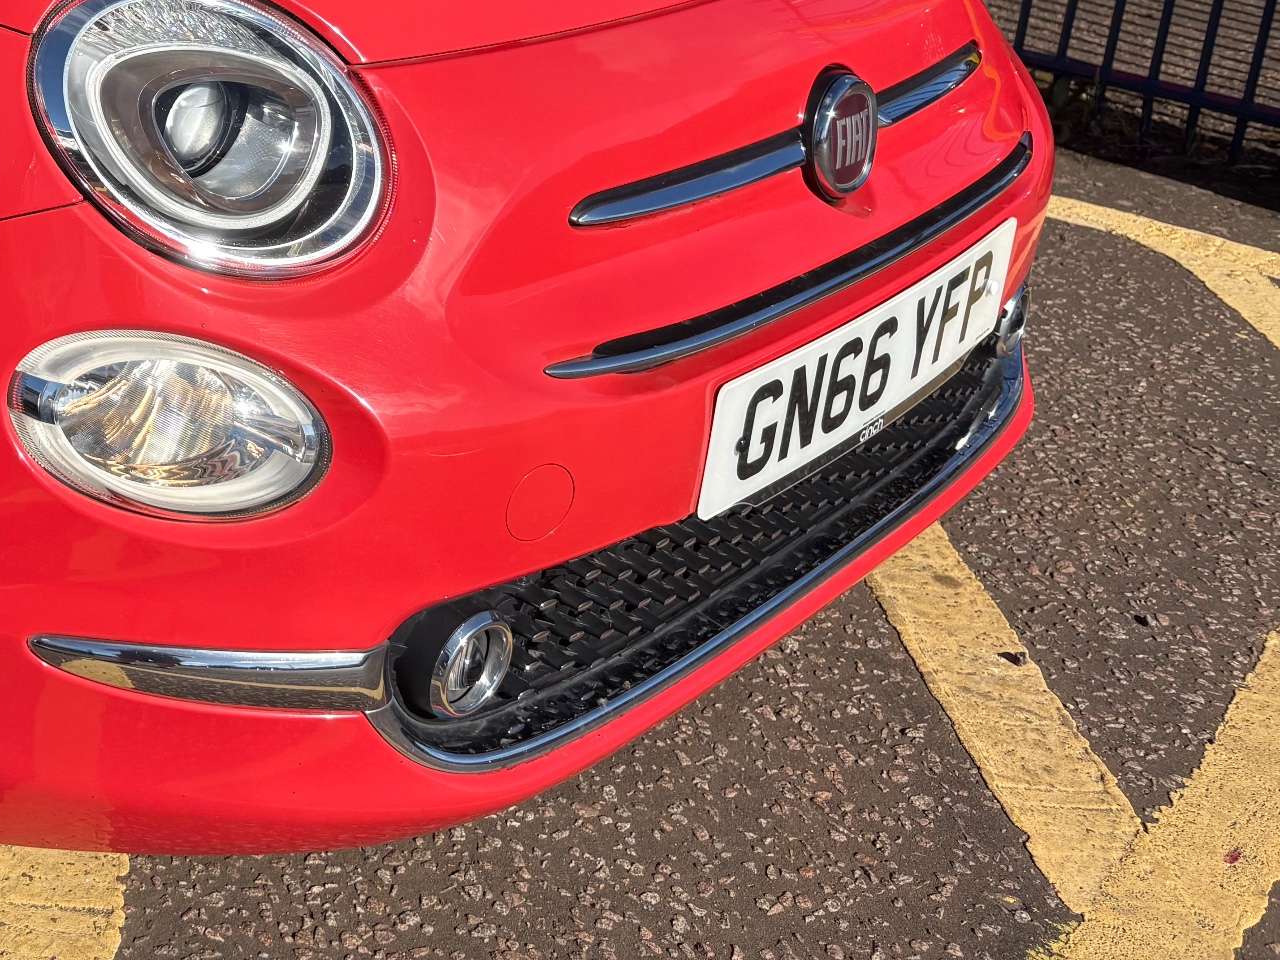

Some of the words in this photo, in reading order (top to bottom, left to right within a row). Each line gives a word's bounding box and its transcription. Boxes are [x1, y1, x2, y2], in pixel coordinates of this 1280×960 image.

[836, 108, 869, 170] FIAT
[736, 316, 899, 481] GN66
[910, 250, 994, 381] YFP
